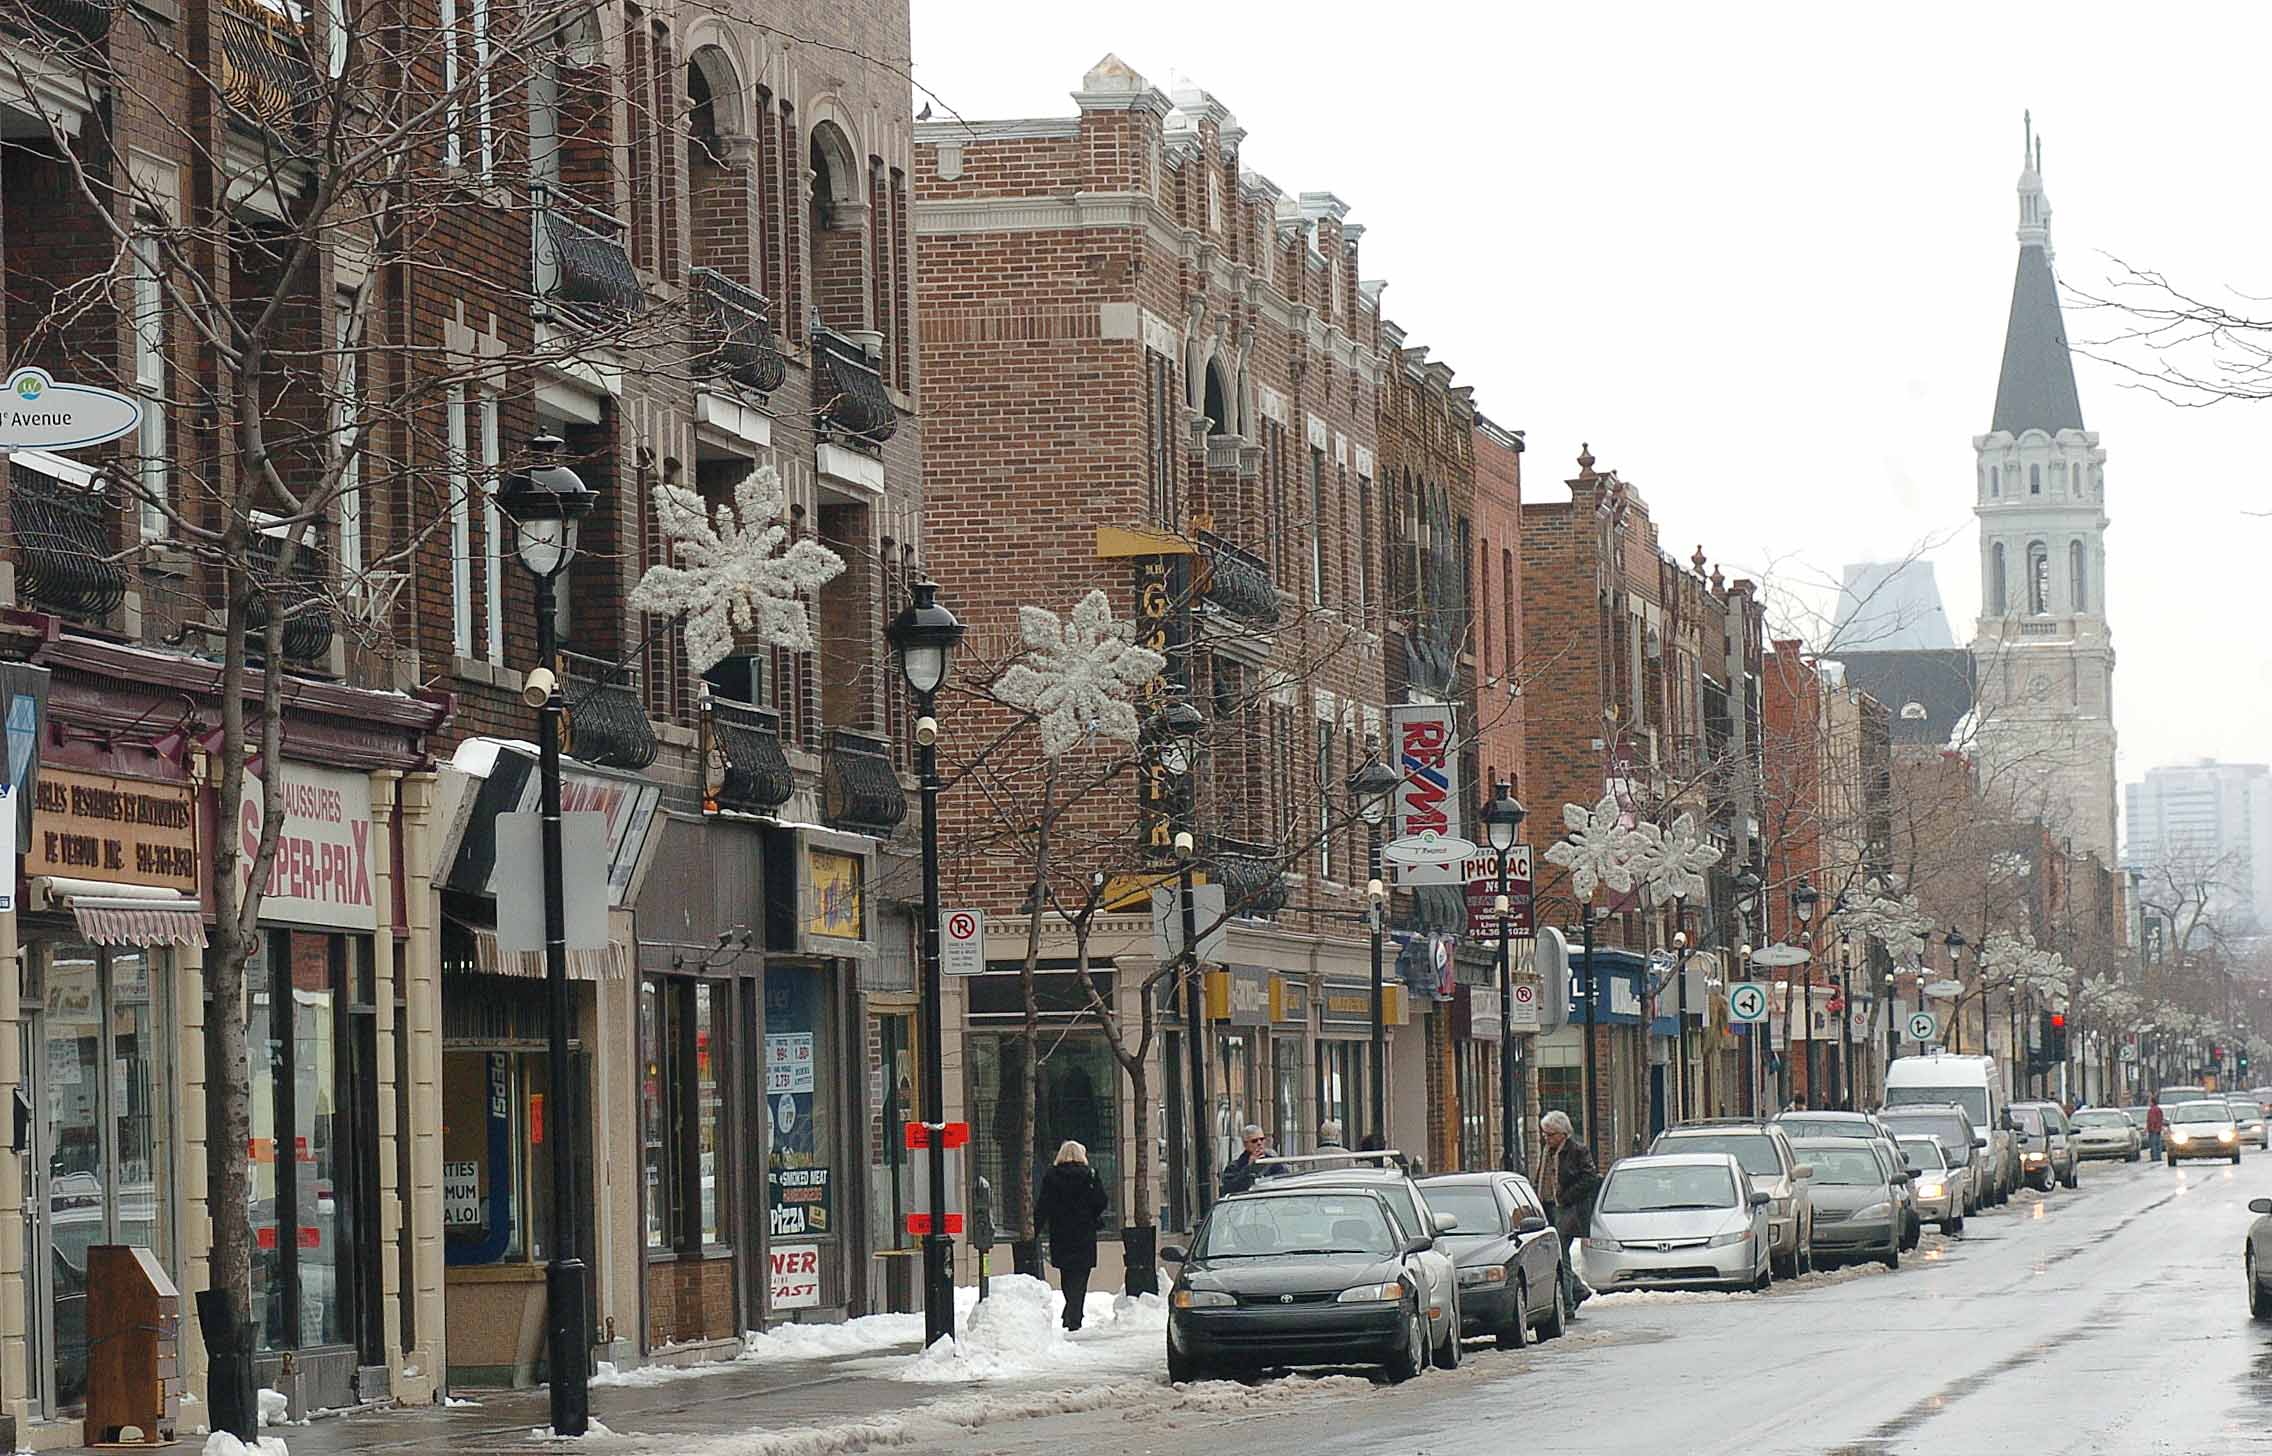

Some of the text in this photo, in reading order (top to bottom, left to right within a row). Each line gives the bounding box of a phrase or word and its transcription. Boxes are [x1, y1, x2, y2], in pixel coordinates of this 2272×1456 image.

[12, 412, 72, 426] Avenue
[281, 781, 342, 823] AUSSURES
[491, 1053, 506, 1118] PEPSI
[782, 1171, 809, 1187] SMOKED
[810, 1170, 828, 1185] MEAT
[445, 1185, 476, 1200] MUM
[456, 1207, 478, 1222] LOI
